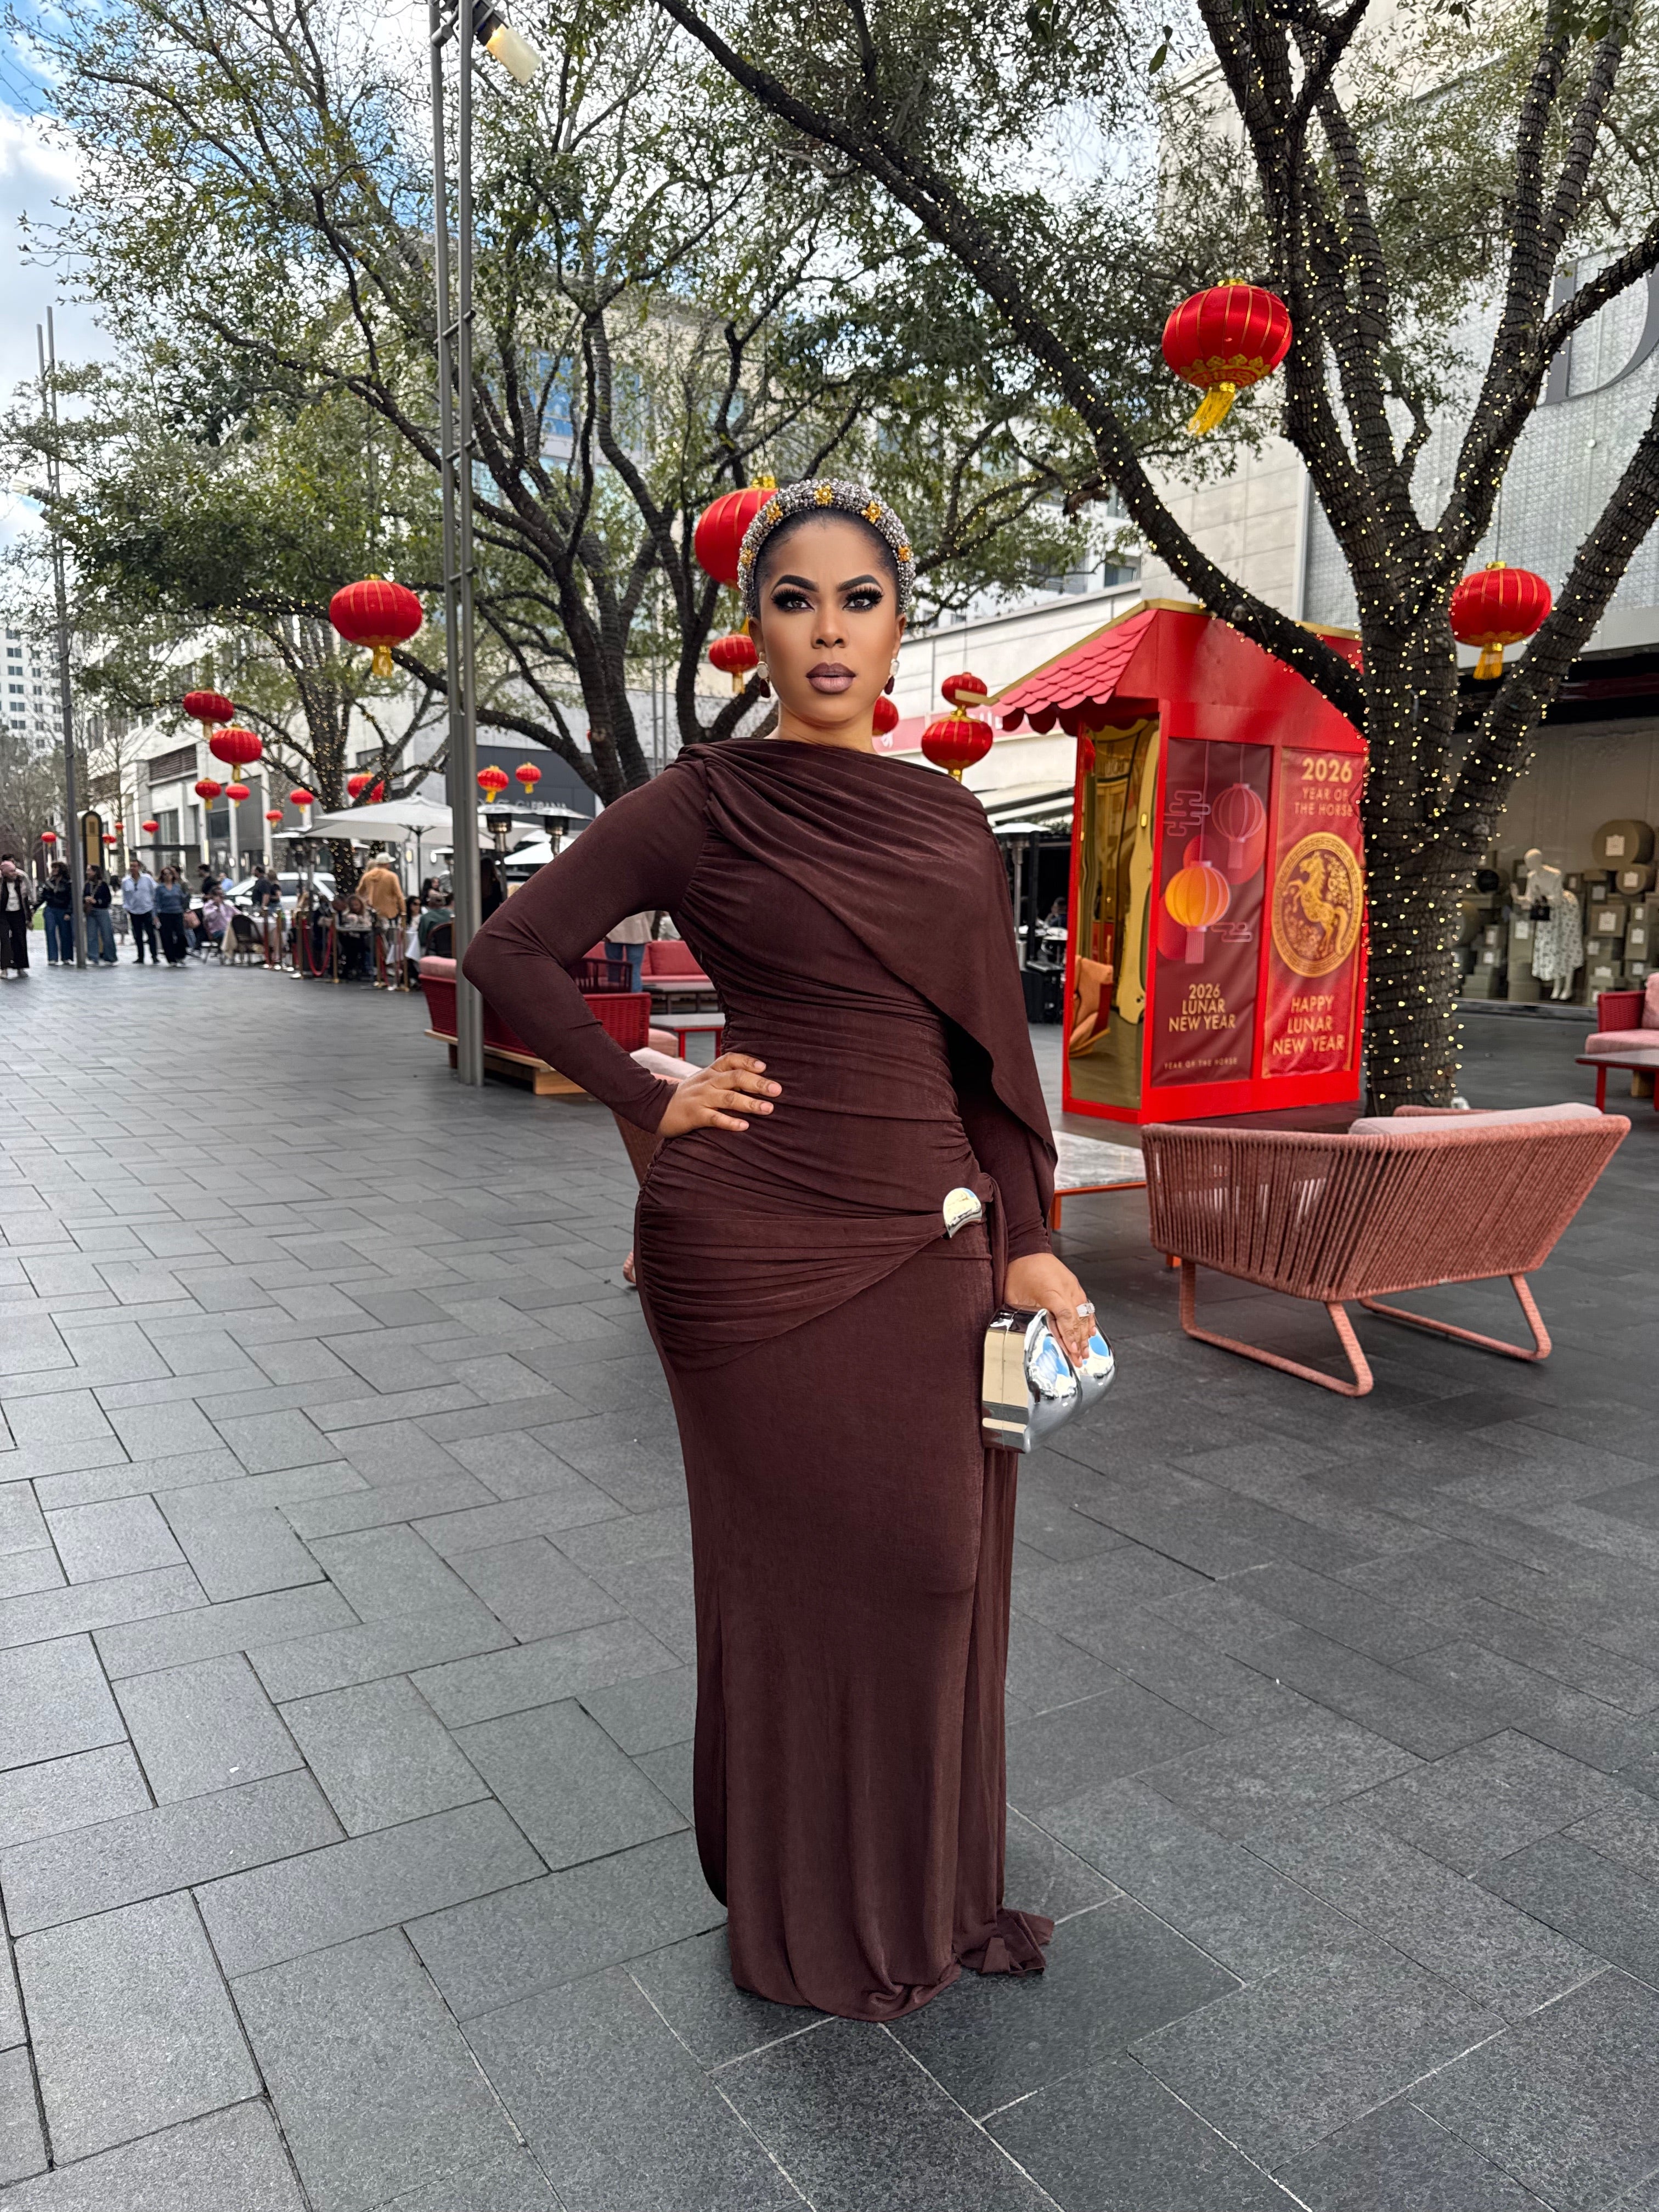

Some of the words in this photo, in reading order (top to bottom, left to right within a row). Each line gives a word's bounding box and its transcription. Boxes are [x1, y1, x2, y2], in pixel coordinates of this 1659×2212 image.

[1301, 758, 1352, 783] 2026
[1302, 787, 1330, 800] YEAR
[1334, 789, 1349, 802] OF
[1295, 802, 1315, 816] THE
[1318, 803, 1353, 817] HORSE
[1188, 984, 1220, 999] 2026
[1182, 998, 1226, 1015] LUNAR
[1291, 995, 1335, 1013] HAPPY
[1169, 1016, 1201, 1032] NEW
[1204, 1014, 1236, 1030] YEAR
[1287, 1015, 1333, 1034] LUNAR
[1272, 1037, 1307, 1056] NEW
[1311, 1034, 1345, 1053] YEAR
[1164, 1061, 1182, 1070] YEAR
[1185, 1060, 1195, 1068] OF
[1214, 1057, 1238, 1065] HORSE
